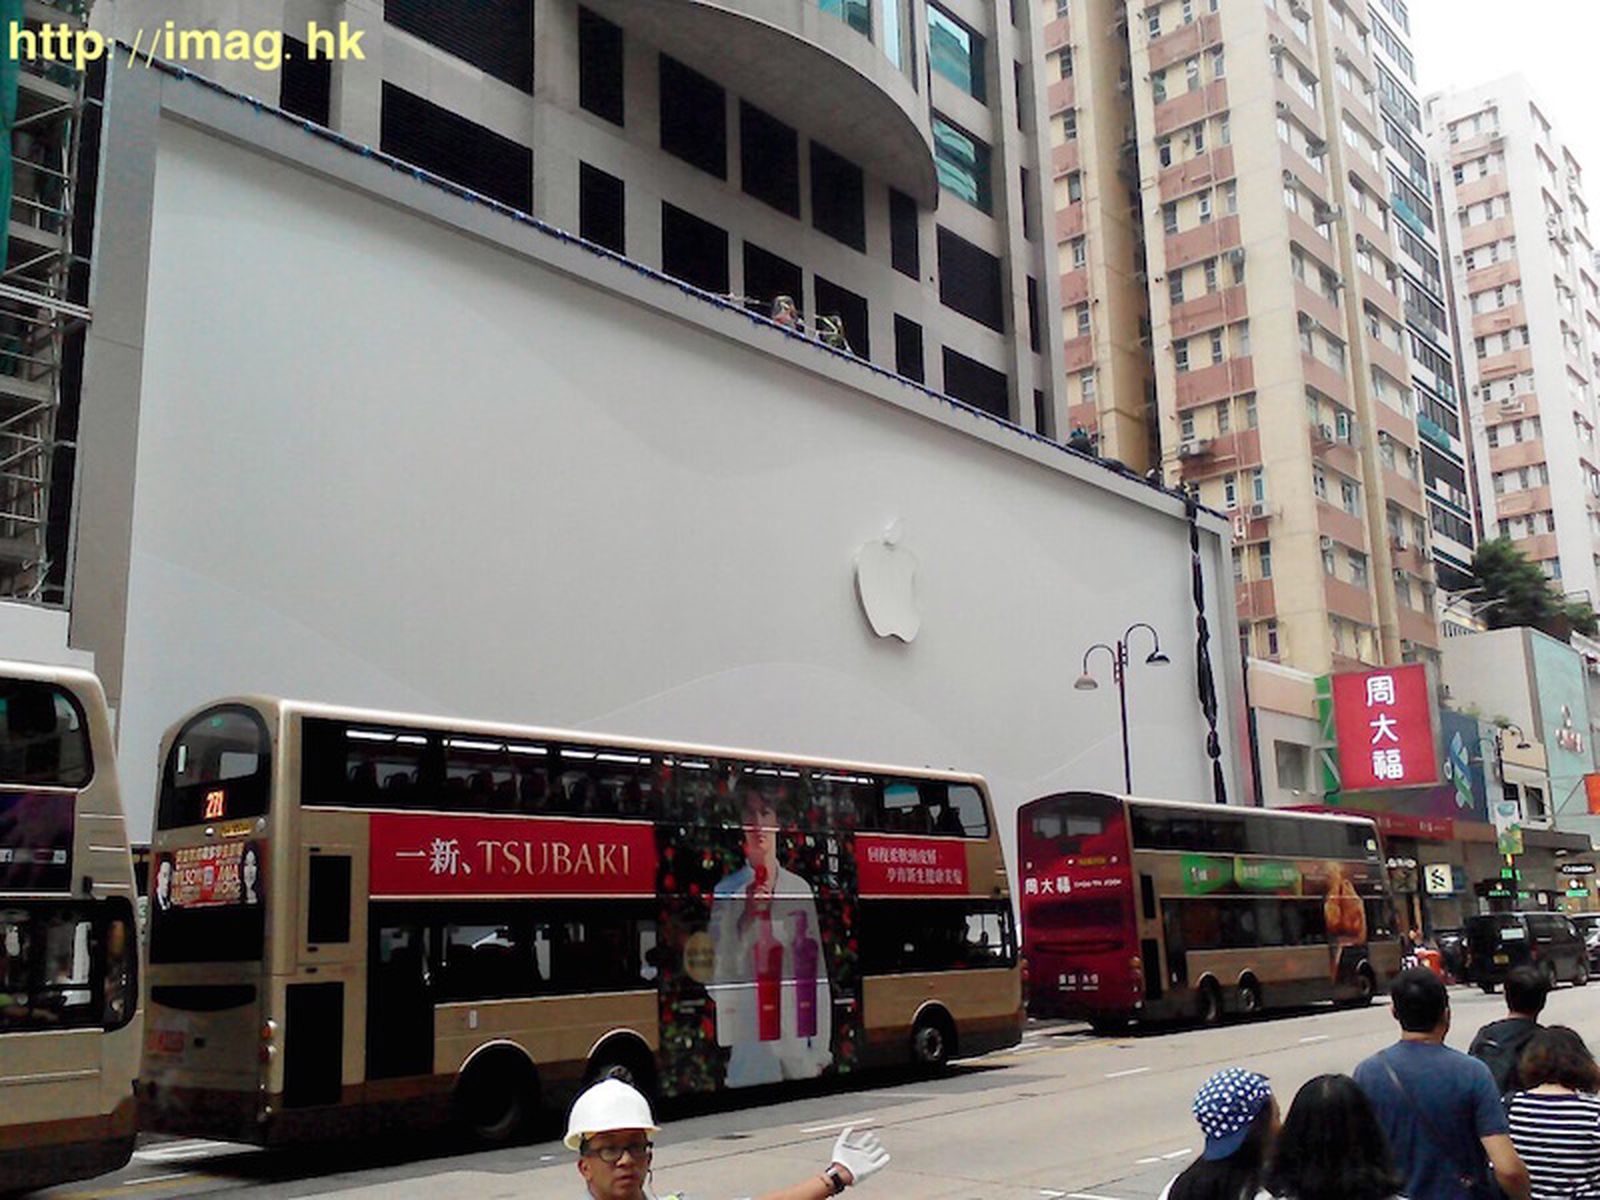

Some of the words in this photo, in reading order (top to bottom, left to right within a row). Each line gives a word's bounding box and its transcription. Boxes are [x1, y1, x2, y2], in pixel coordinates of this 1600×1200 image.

[1366, 675, 1404, 780] 周大福
[205, 791, 224, 819] 271
[476, 840, 630, 876] TSUBAKI
